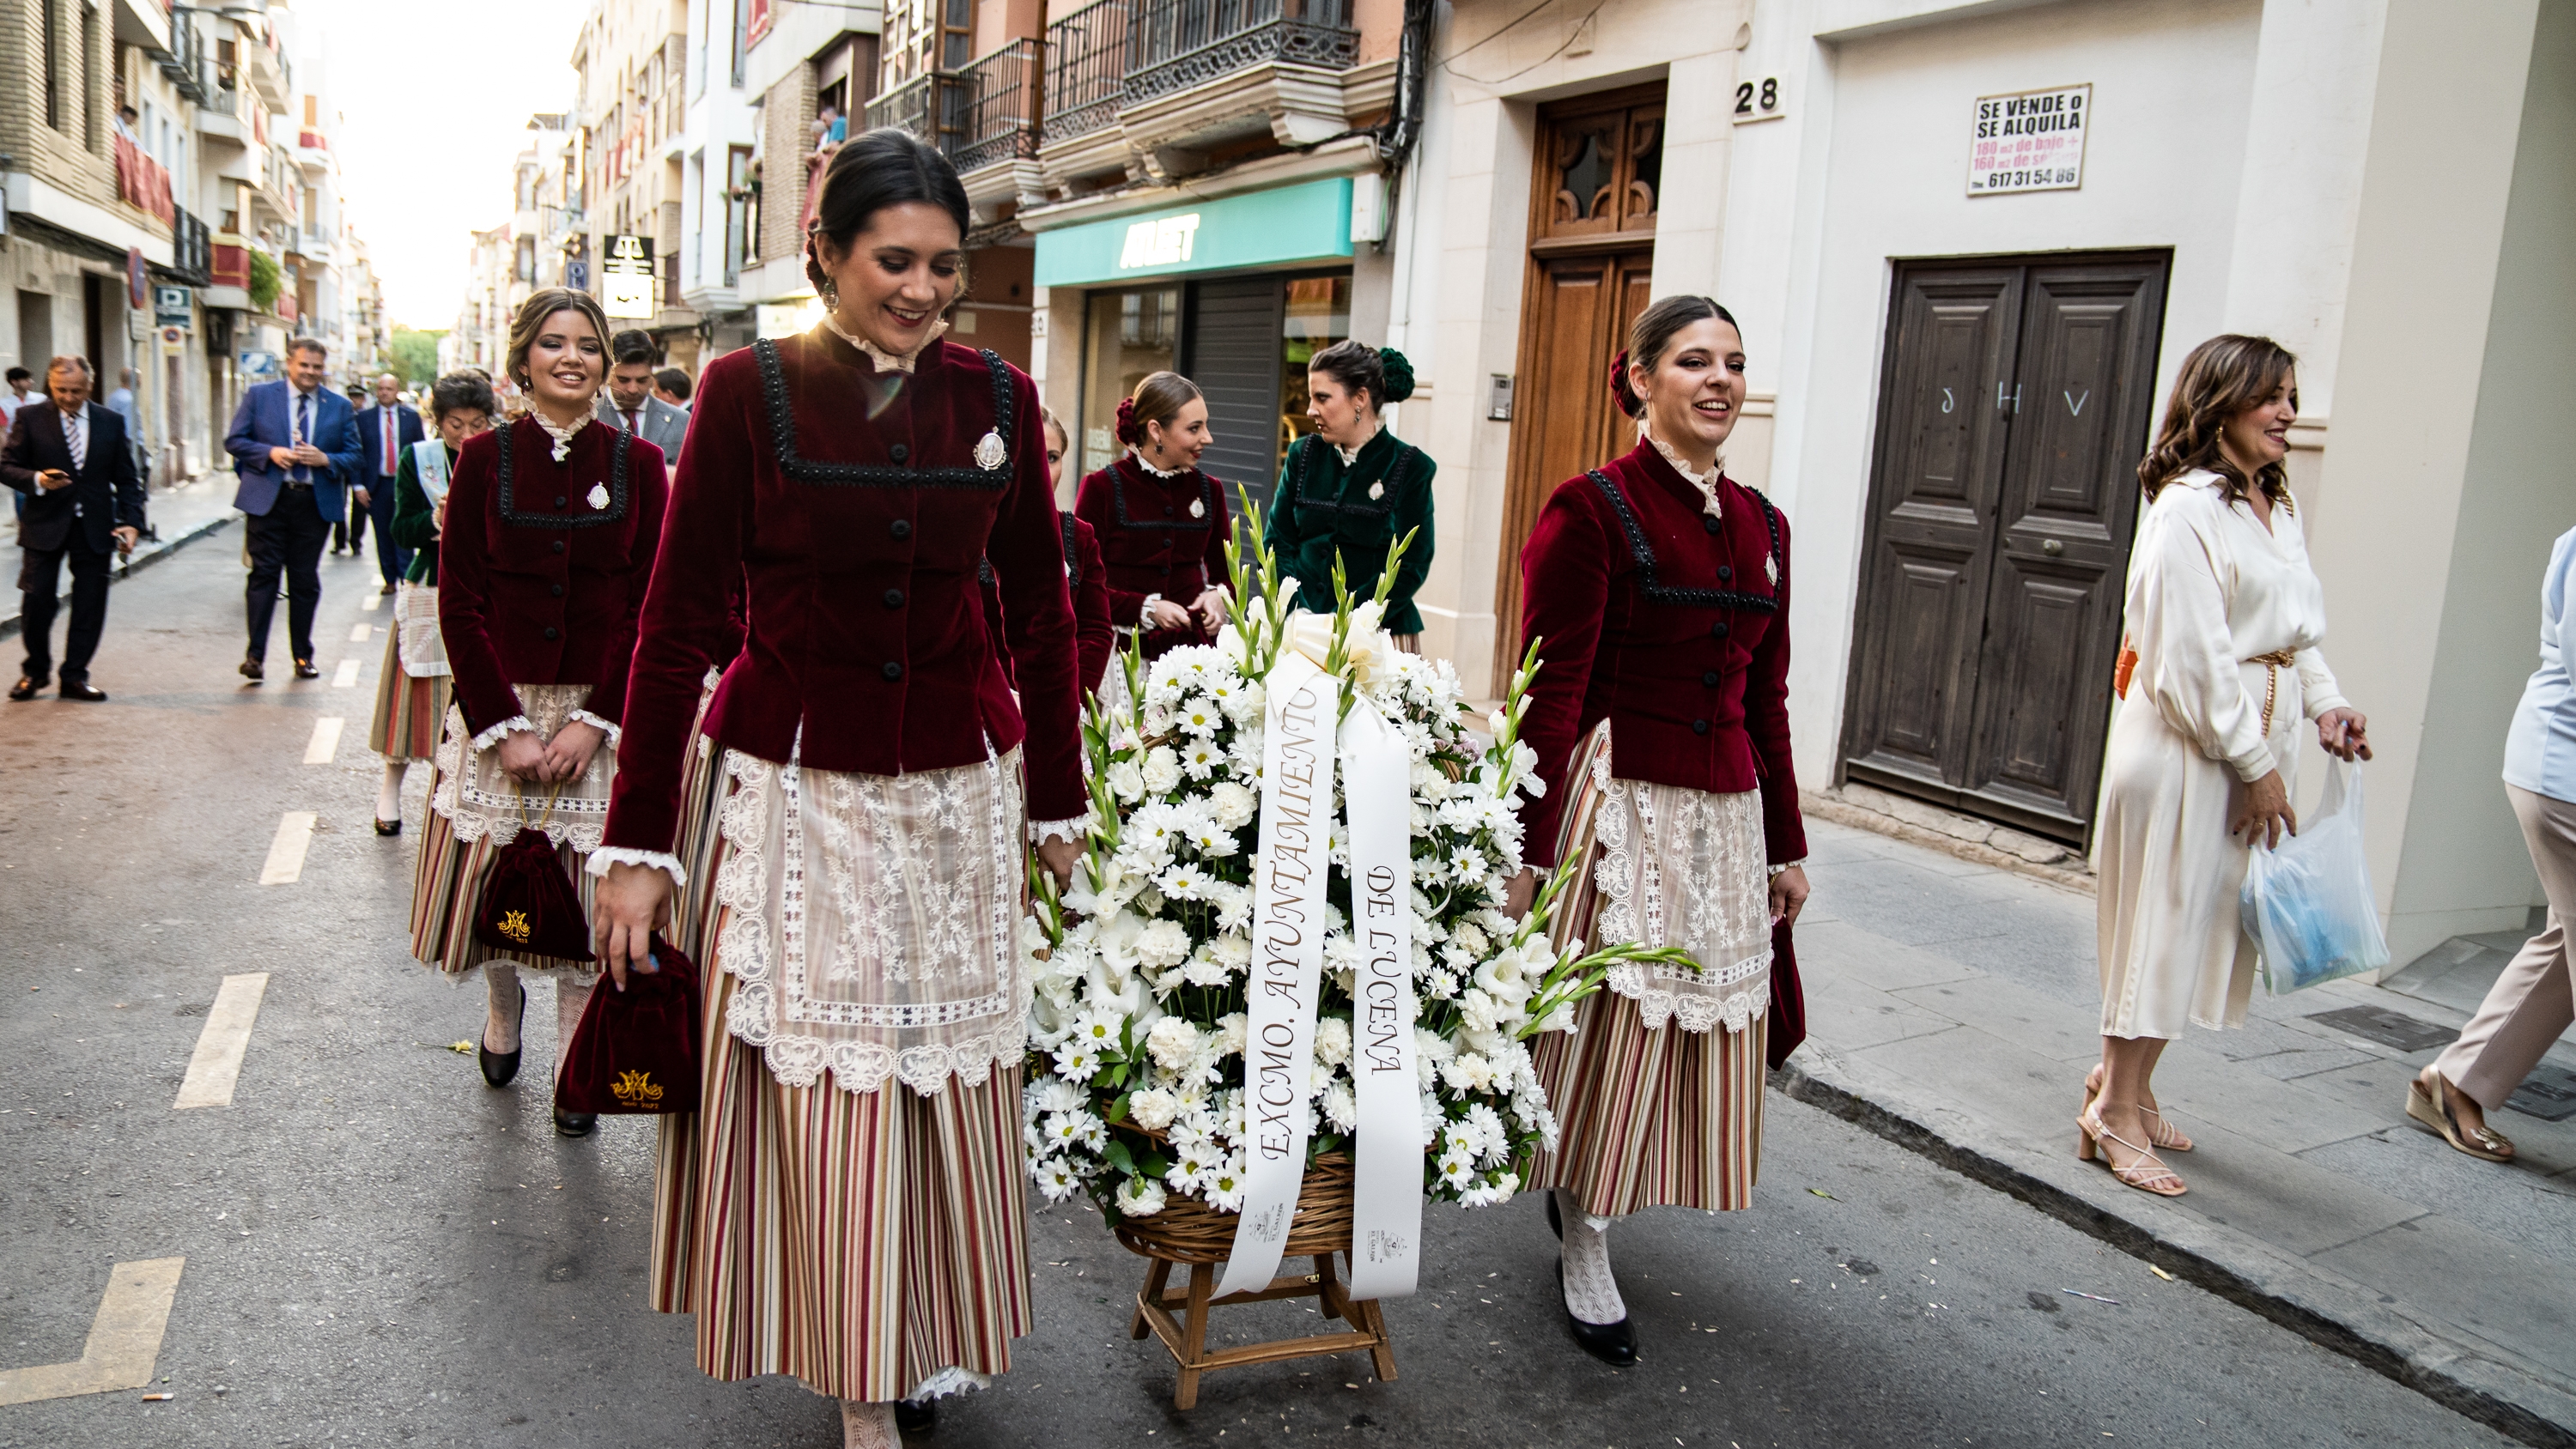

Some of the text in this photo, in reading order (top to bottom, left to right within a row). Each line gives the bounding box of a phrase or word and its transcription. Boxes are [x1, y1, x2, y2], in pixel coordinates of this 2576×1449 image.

[1735, 77, 1777, 113] 28
[1980, 102, 2001, 119] SE
[2006, 94, 2065, 117] VENDE
[1978, 112, 2081, 138] SE ALQUILA
[1976, 141, 1998, 156] 180
[2016, 138, 2032, 153] de
[2035, 136, 2065, 151] bajo
[1974, 156, 1996, 171] 160
[2014, 154, 2030, 167] de
[1989, 173, 2012, 188] 617
[2014, 171, 2032, 186] 31
[2033, 168, 2053, 185] 54
[1120, 213, 1200, 270] ATLEET
[1996, 381, 2022, 414] H
[2063, 389, 2089, 416] V
[1256, 687, 1318, 1161] EXCMO. AYUNTAMIENTO
[1364, 865, 1403, 1076] DE LUCENA
